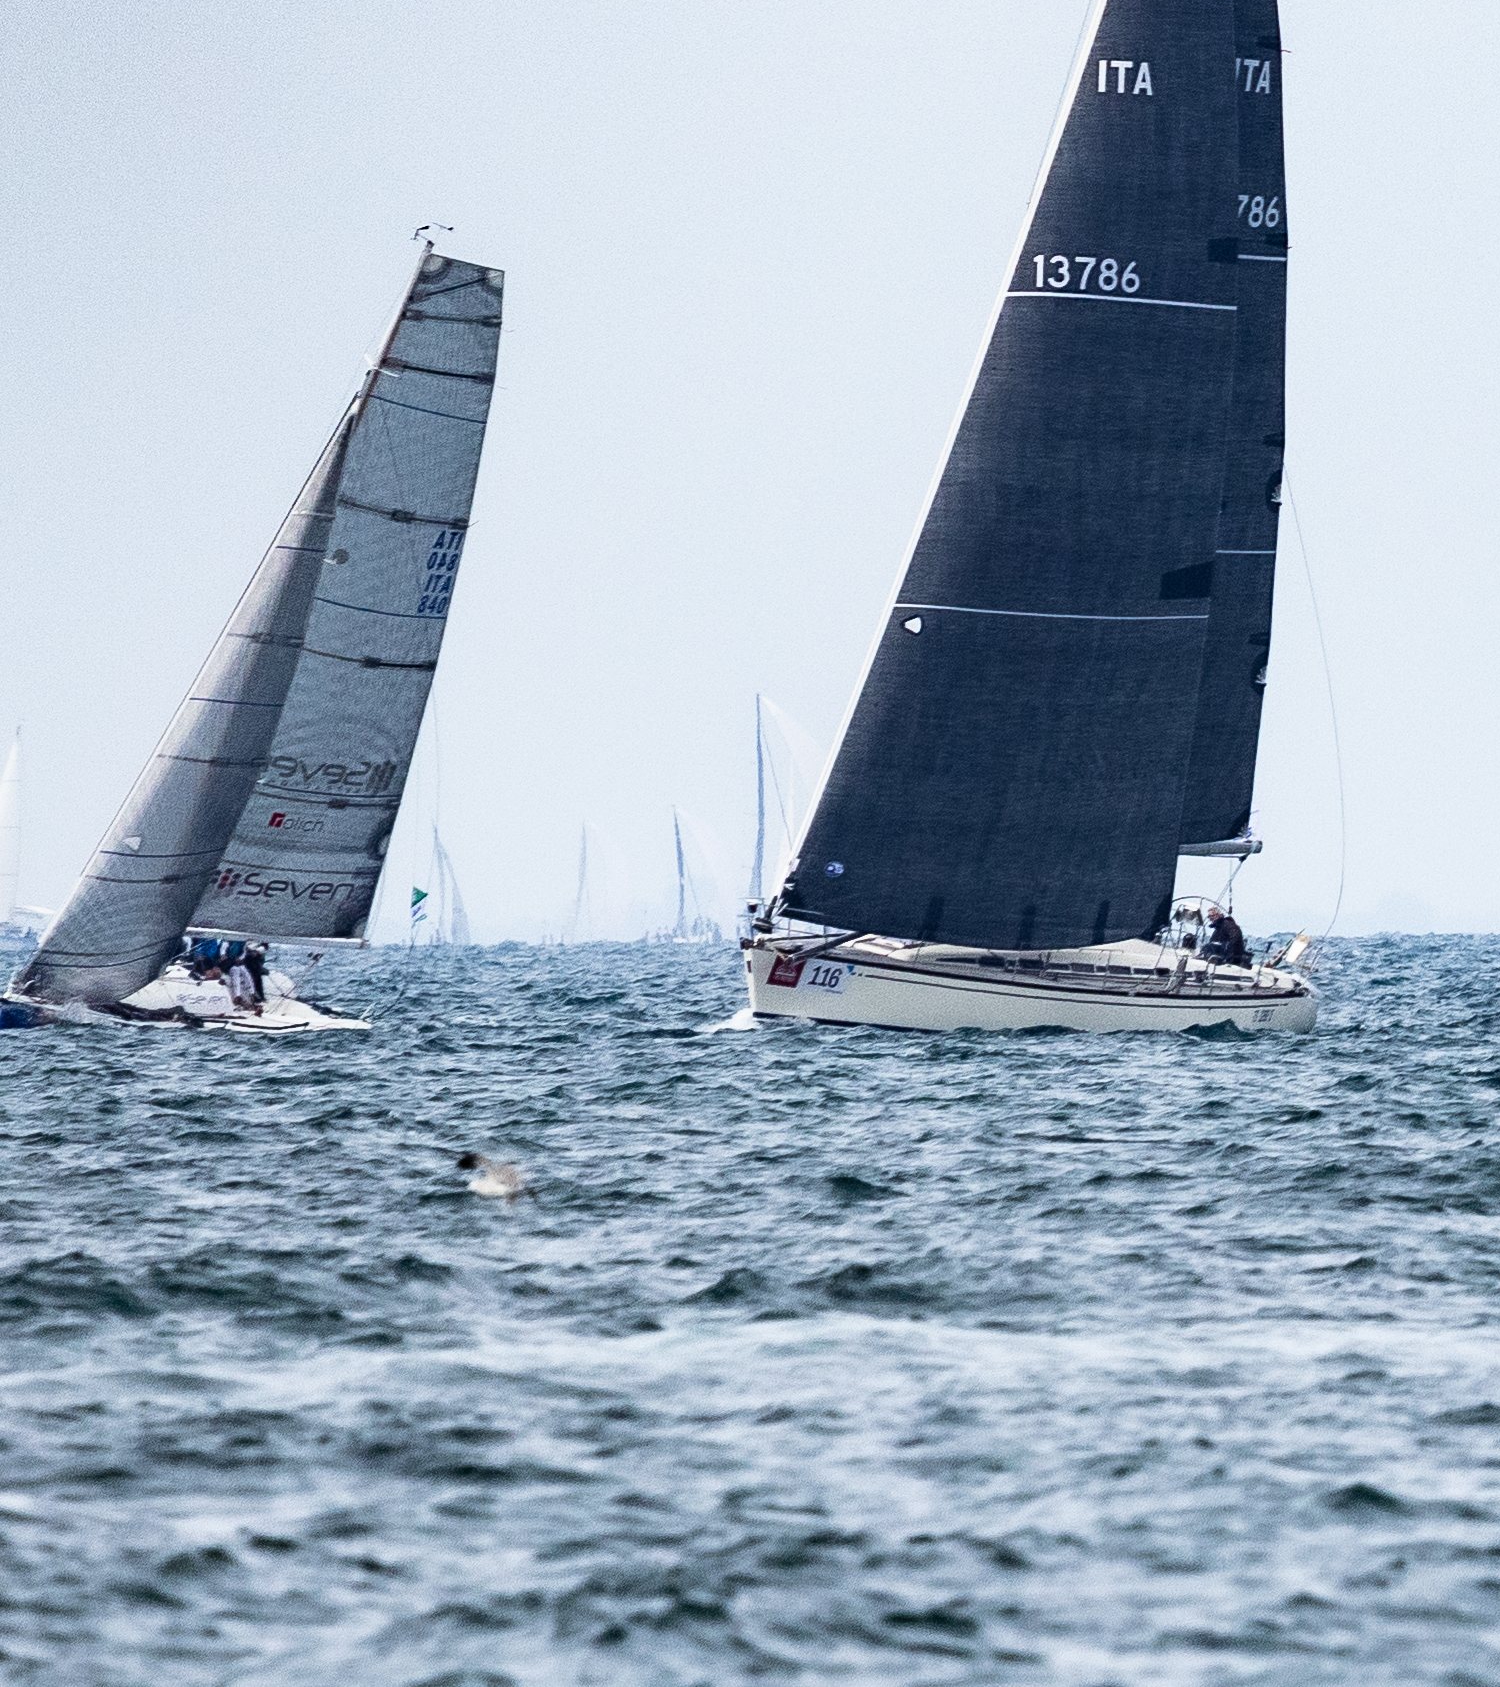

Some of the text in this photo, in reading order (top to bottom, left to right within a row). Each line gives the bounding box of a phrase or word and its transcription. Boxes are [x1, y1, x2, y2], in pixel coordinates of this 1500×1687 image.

[1098, 60, 1153, 96] ITA
[1033, 255, 1140, 293] 13786
[424, 573, 452, 593] ITA
[418, 594, 450, 614] 840
[237, 872, 355, 901] Seven
[807, 965, 843, 989] 116
